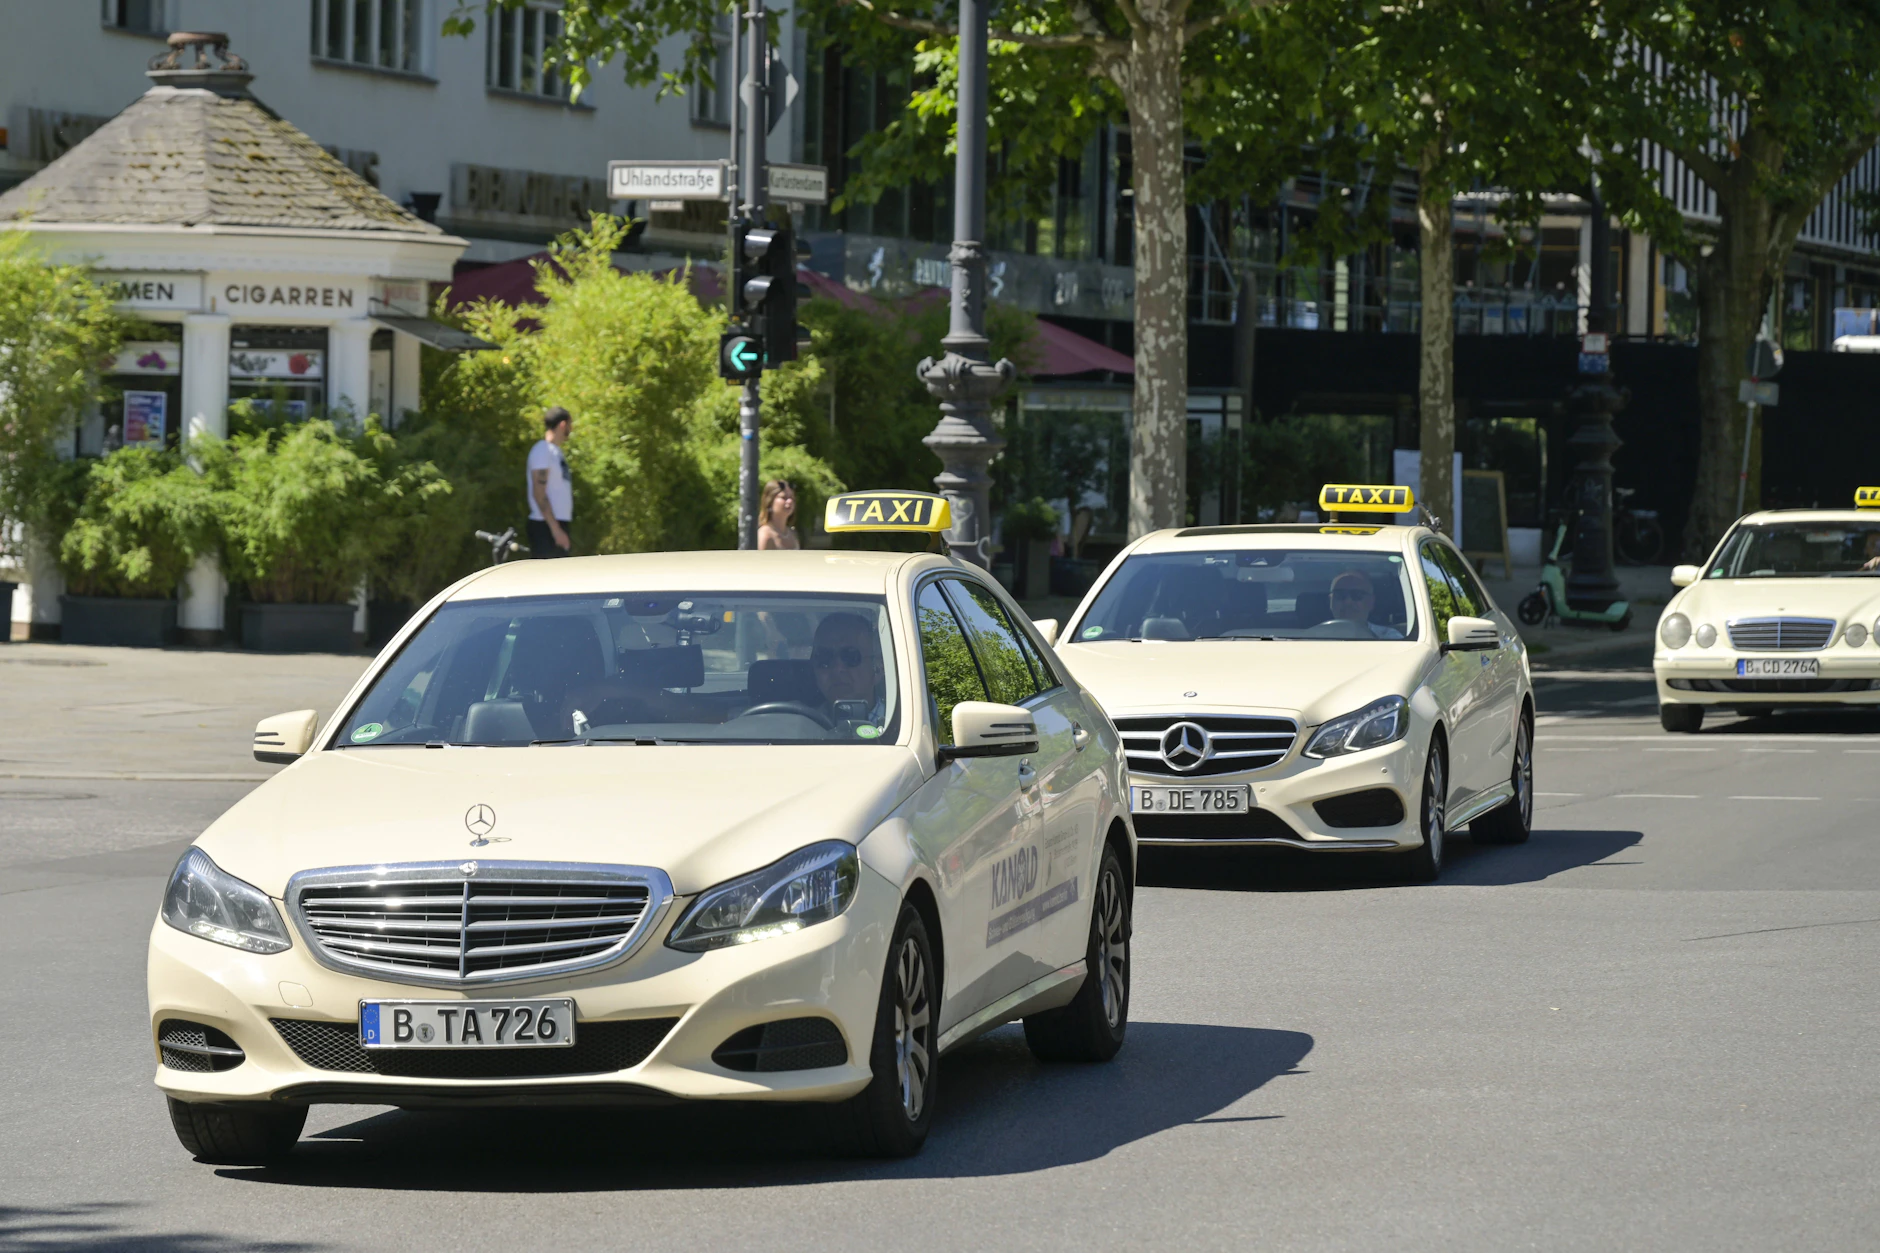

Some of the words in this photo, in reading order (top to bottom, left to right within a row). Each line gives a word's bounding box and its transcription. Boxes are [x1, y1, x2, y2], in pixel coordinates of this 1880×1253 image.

[619, 169, 714, 190] Uhlandstraße
[225, 285, 354, 307] CIGARREN
[1334, 488, 1395, 504] TAXI
[845, 499, 924, 523] TAXI
[1746, 660, 1754, 674] B
[1141, 790, 1153, 810] B
[1200, 789, 1239, 810] 785
[991, 845, 1038, 910] KANOLD
[393, 1008, 413, 1043] B
